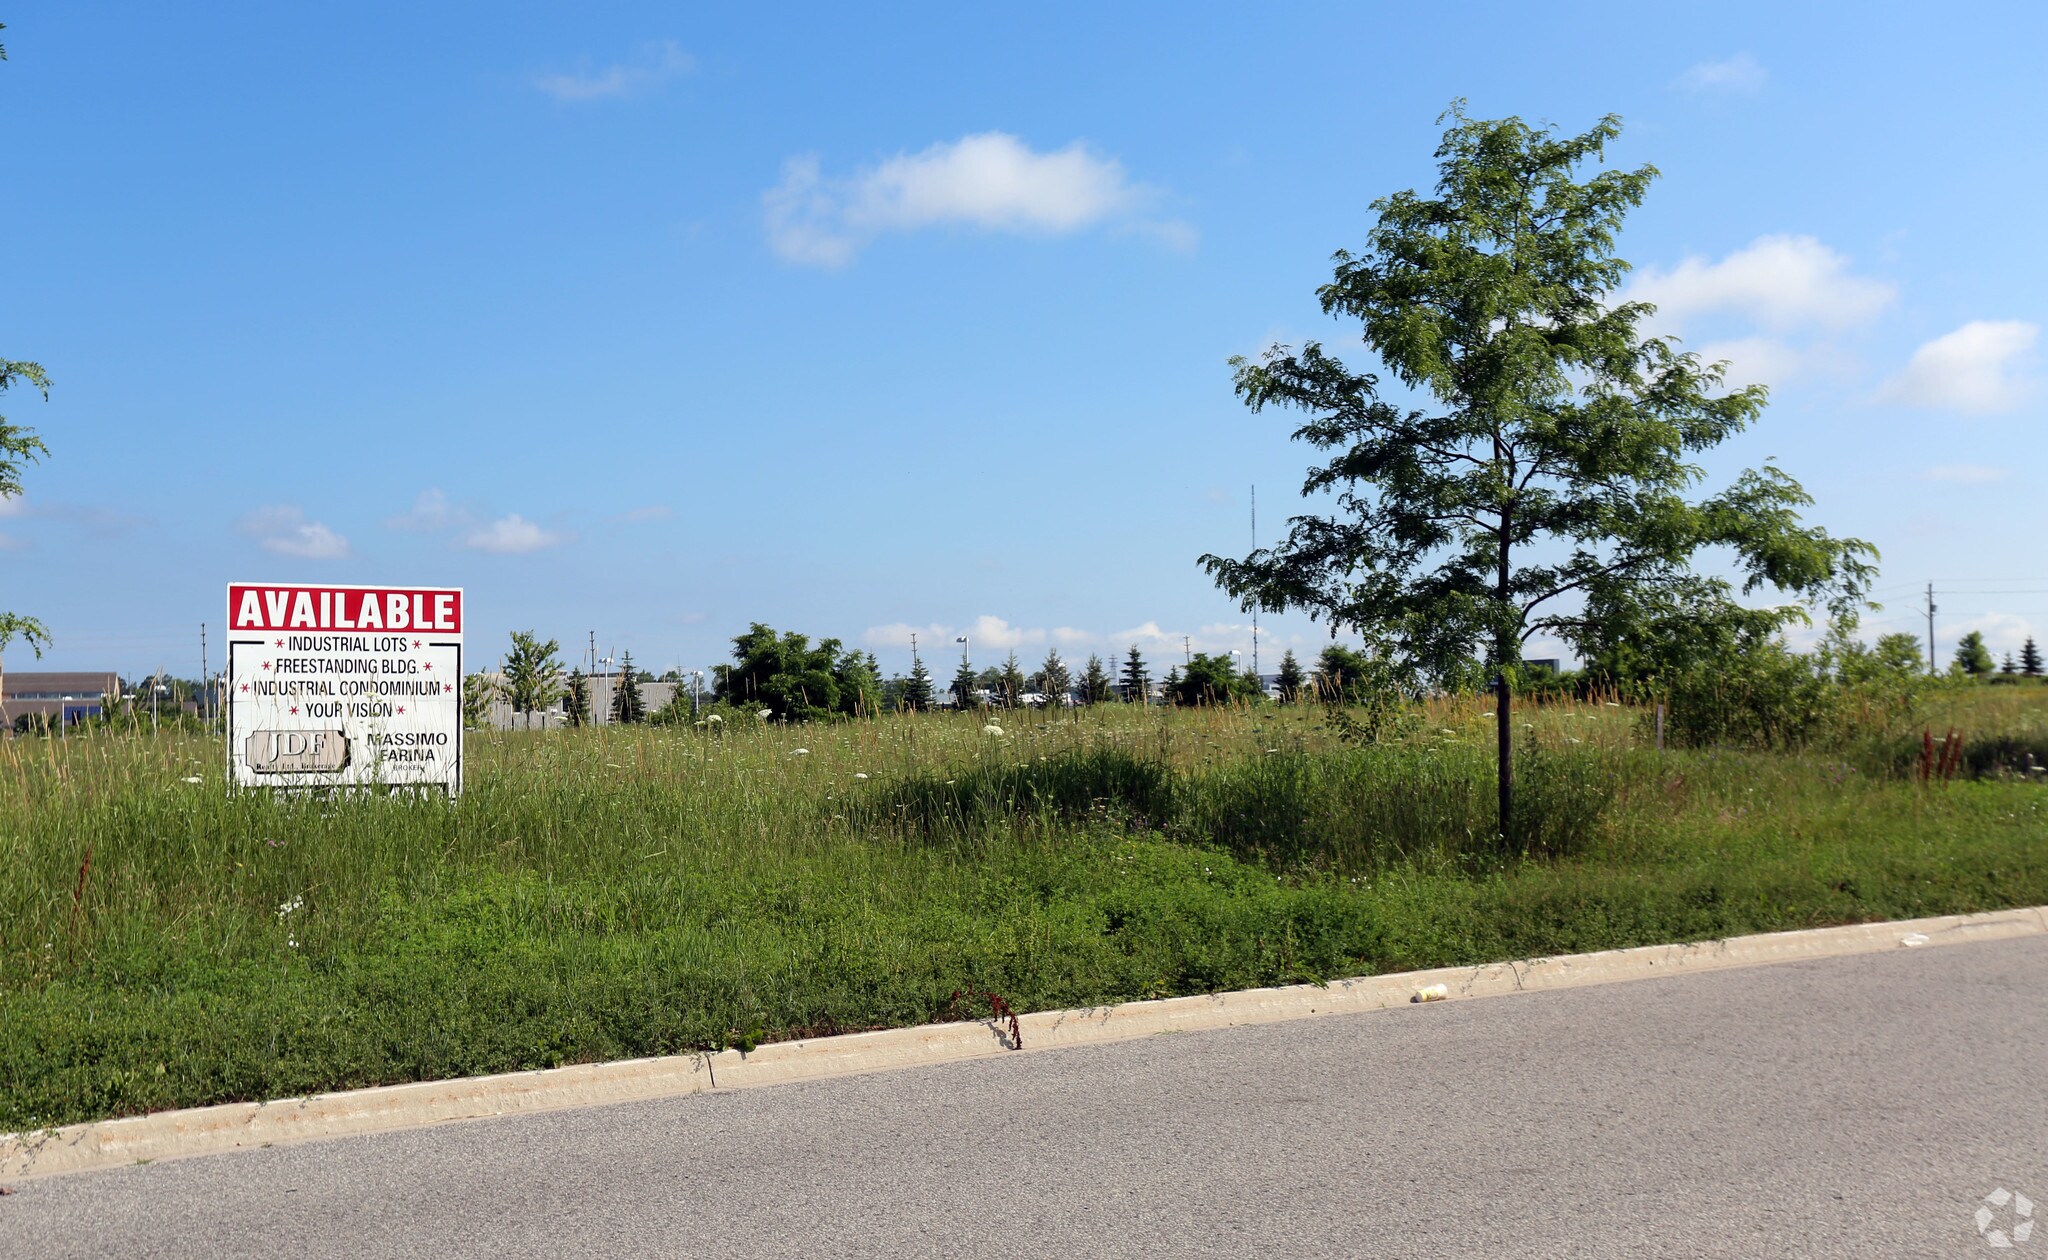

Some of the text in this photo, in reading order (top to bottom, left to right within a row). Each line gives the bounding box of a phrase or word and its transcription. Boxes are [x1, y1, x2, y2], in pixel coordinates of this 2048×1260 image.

[236, 590, 456, 630] AVAILABLE
[288, 636, 407, 652] INDUSTRIAL LOTS
[276, 658, 420, 675] FREESTANDING BLDG.
[253, 680, 441, 696] INDUSTRIAL CONDOMINIUM
[305, 703, 393, 718] YOUR VISION
[269, 732, 327, 763] JDF
[367, 733, 448, 746] MASSIMO
[380, 749, 435, 762] FARINA
